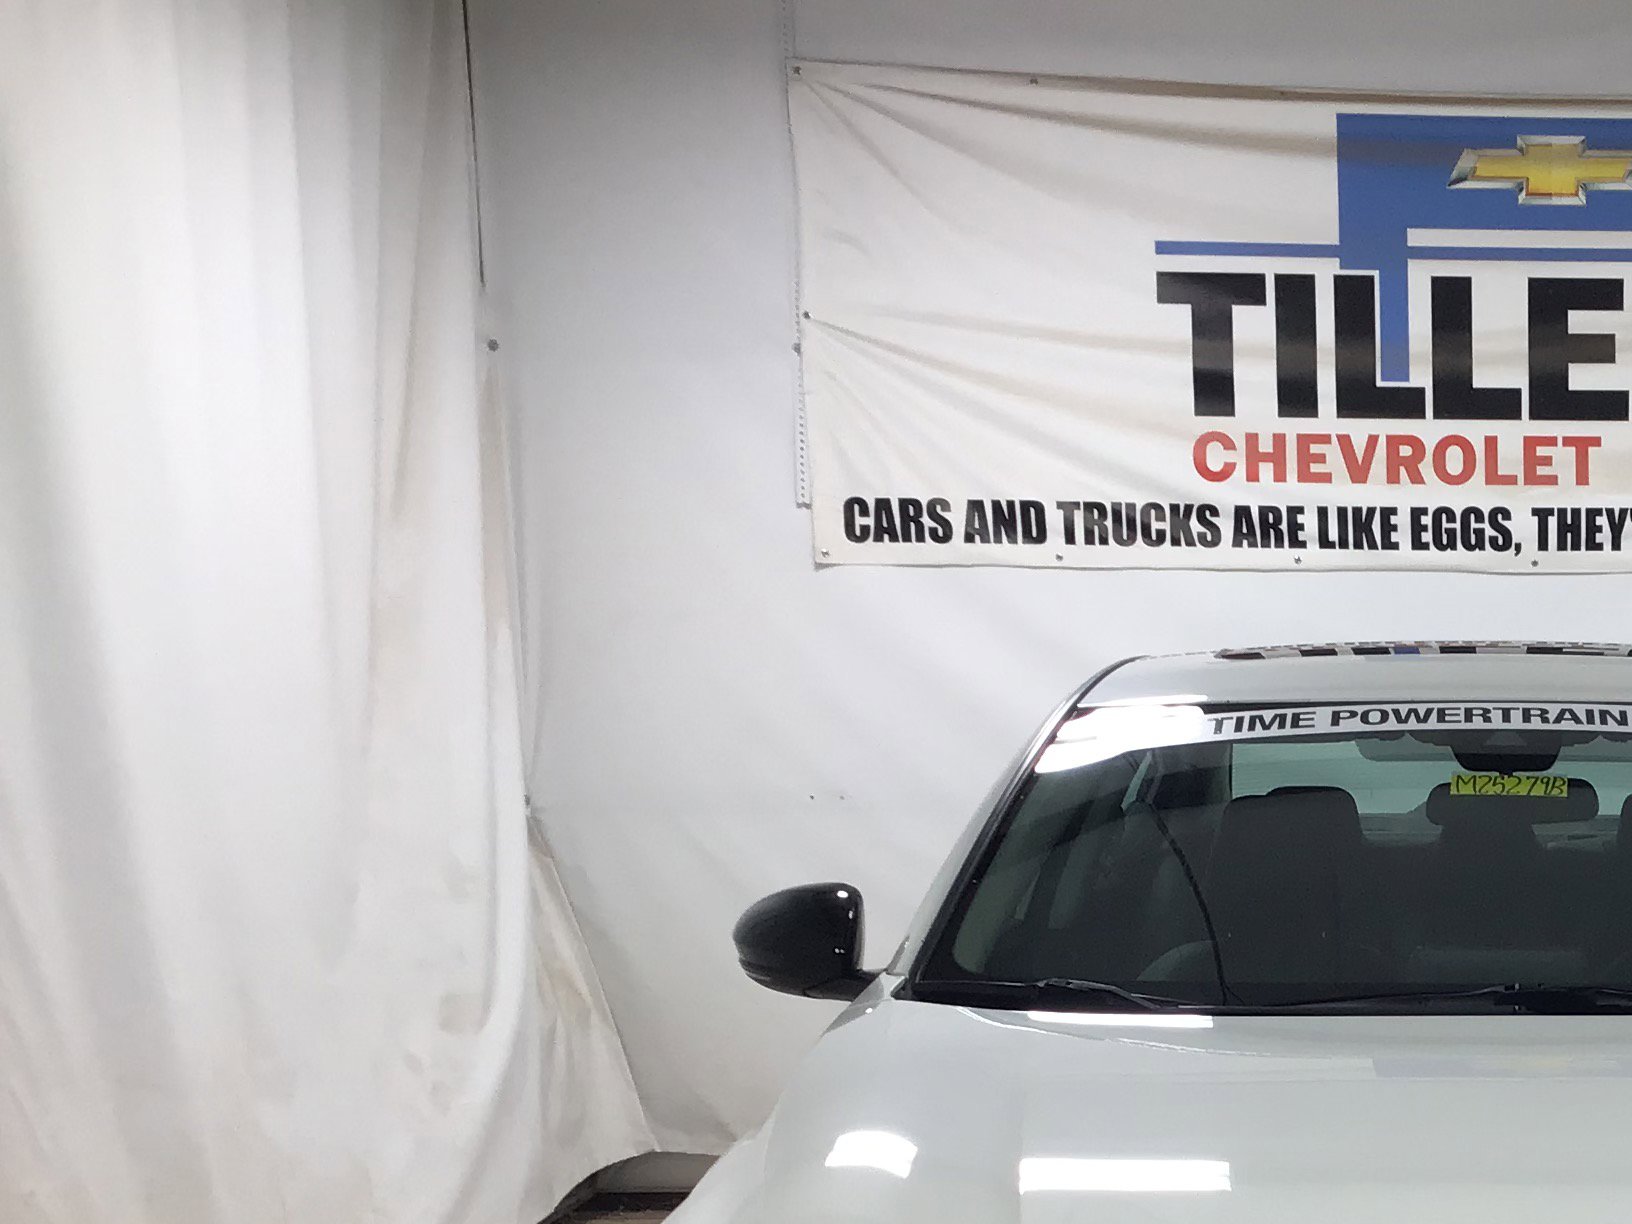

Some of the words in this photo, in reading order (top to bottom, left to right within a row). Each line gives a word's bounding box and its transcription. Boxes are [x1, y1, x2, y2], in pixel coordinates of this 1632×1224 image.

[1193, 430, 1602, 486] CHEVROLET
[843, 496, 953, 544] CARS
[963, 498, 1048, 545] AND
[1056, 500, 1222, 548] TRUCKS
[1231, 504, 1307, 549] ARE
[1317, 506, 1399, 551] LIKE
[1410, 506, 1522, 556] EGGS,
[1330, 705, 1630, 730] POWERTRAIN
